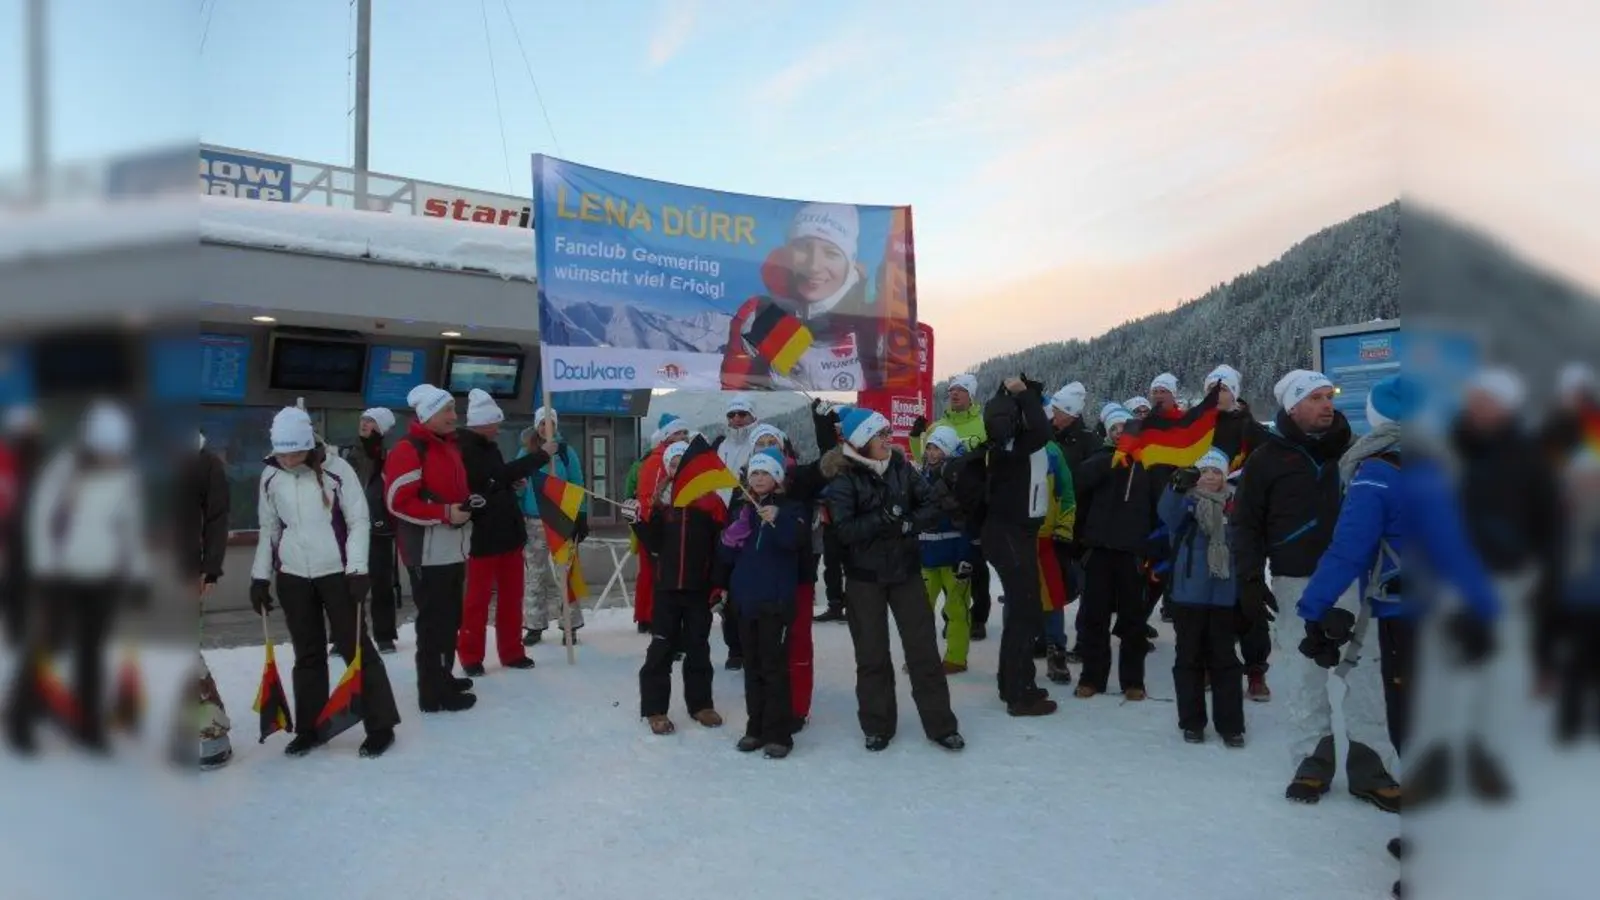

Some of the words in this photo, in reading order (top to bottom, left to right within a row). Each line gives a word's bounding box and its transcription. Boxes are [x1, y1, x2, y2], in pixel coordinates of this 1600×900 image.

[556, 184, 654, 232] LENA
[661, 203, 756, 245] DÜRR
[554, 236, 627, 259] Fanclub
[632, 247, 720, 277] Germering
[554, 263, 628, 286] wünscht
[634, 270, 665, 287] viel
[670, 276, 725, 300] Erfolg!
